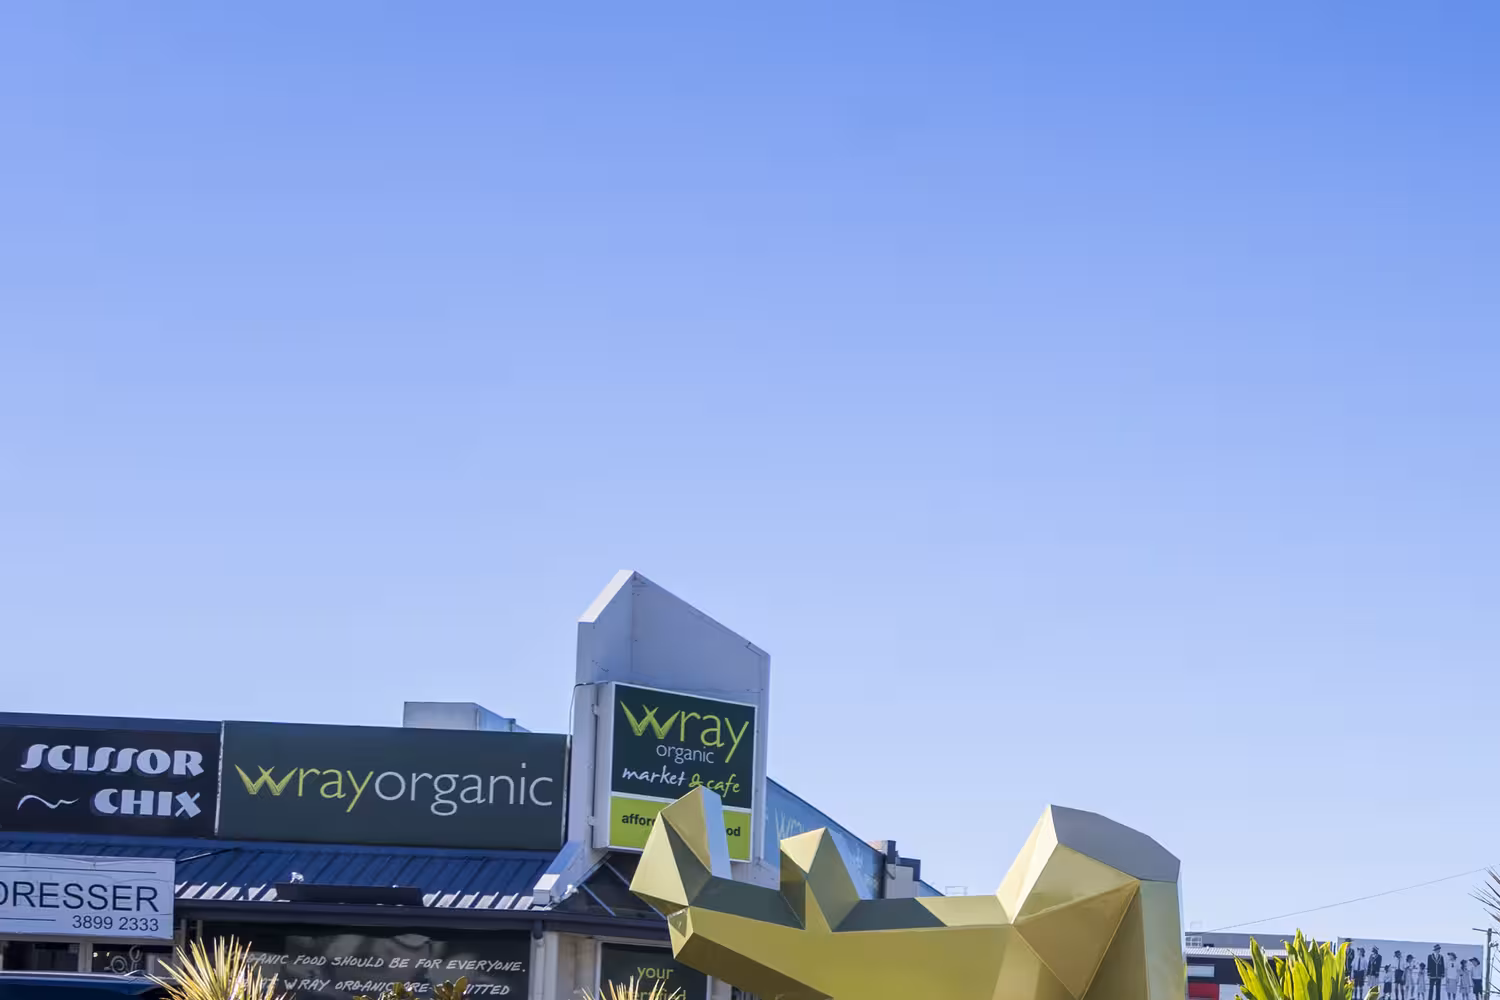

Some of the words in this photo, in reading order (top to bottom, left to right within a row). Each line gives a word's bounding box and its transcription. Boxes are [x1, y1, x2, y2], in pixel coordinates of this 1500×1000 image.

[20, 743, 205, 777] SCISSOR
[656, 744, 714, 765] organic
[622, 765, 686, 787] market
[688, 773, 704, 788] &
[706, 773, 741, 798] cafe
[93, 788, 202, 818] CHIX
[72, 915, 113, 930] 3899
[118, 916, 159, 932] 2333
[293, 954, 327, 966] FOOD
[331, 955, 385, 968] SHOULD
[388, 957, 410, 969] BE
[415, 958, 443, 970] FOR
[446, 959, 526, 973] EVERYONE.
[637, 966, 675, 980] your
[284, 978, 331, 992] WRAY
[335, 980, 394, 992] ORGANIC
